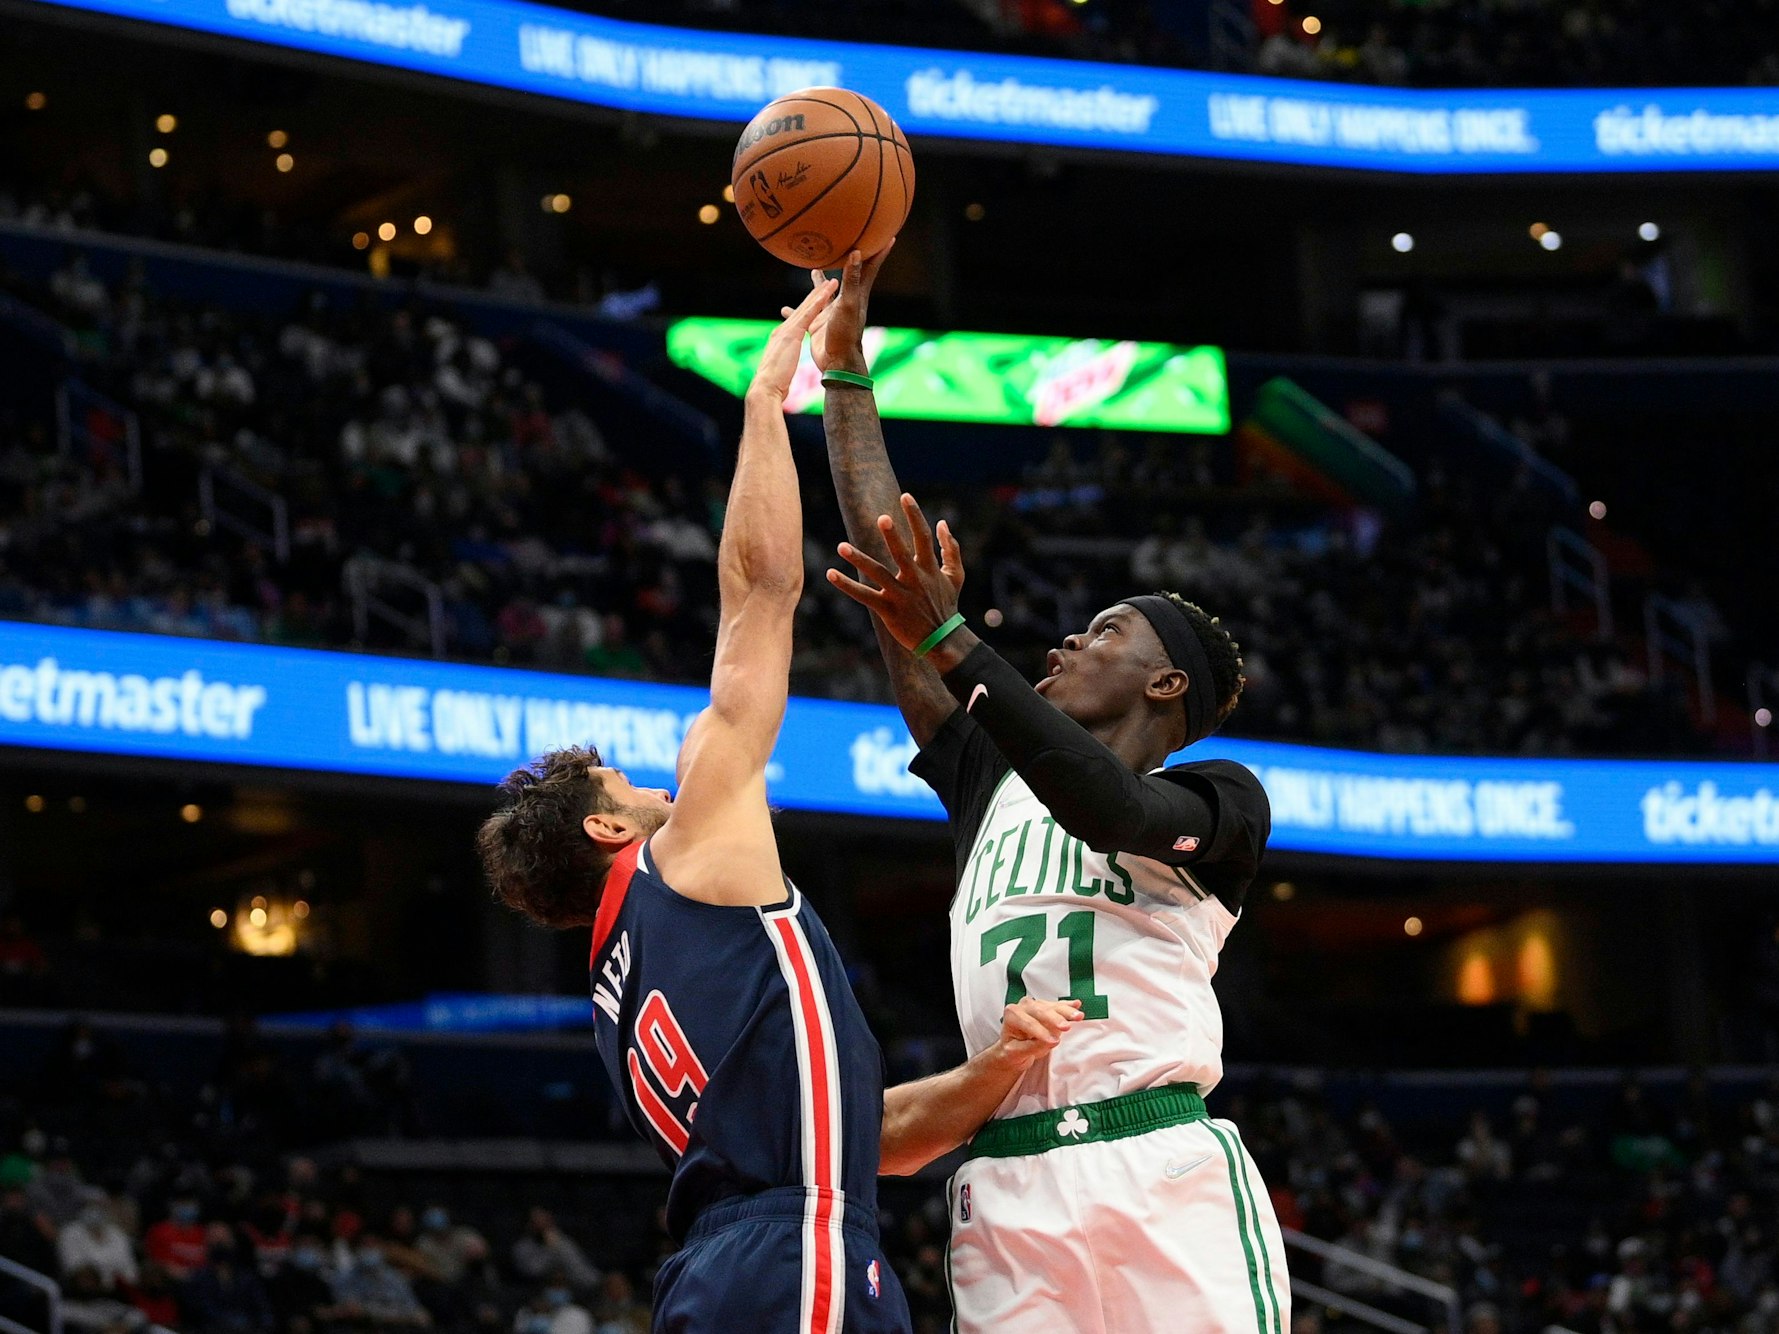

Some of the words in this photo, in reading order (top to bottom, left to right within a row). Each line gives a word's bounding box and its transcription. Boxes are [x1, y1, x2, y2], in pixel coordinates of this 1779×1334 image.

[906, 68, 1158, 133] ticketmaster
[0, 657, 267, 740] etmaster
[346, 680, 431, 753] LIVE
[431, 690, 523, 759] ONLY
[1640, 779, 1779, 846] ticket
[964, 815, 1135, 906] CELTICS
[979, 910, 1110, 1024] 71
[626, 988, 711, 1158] 19
